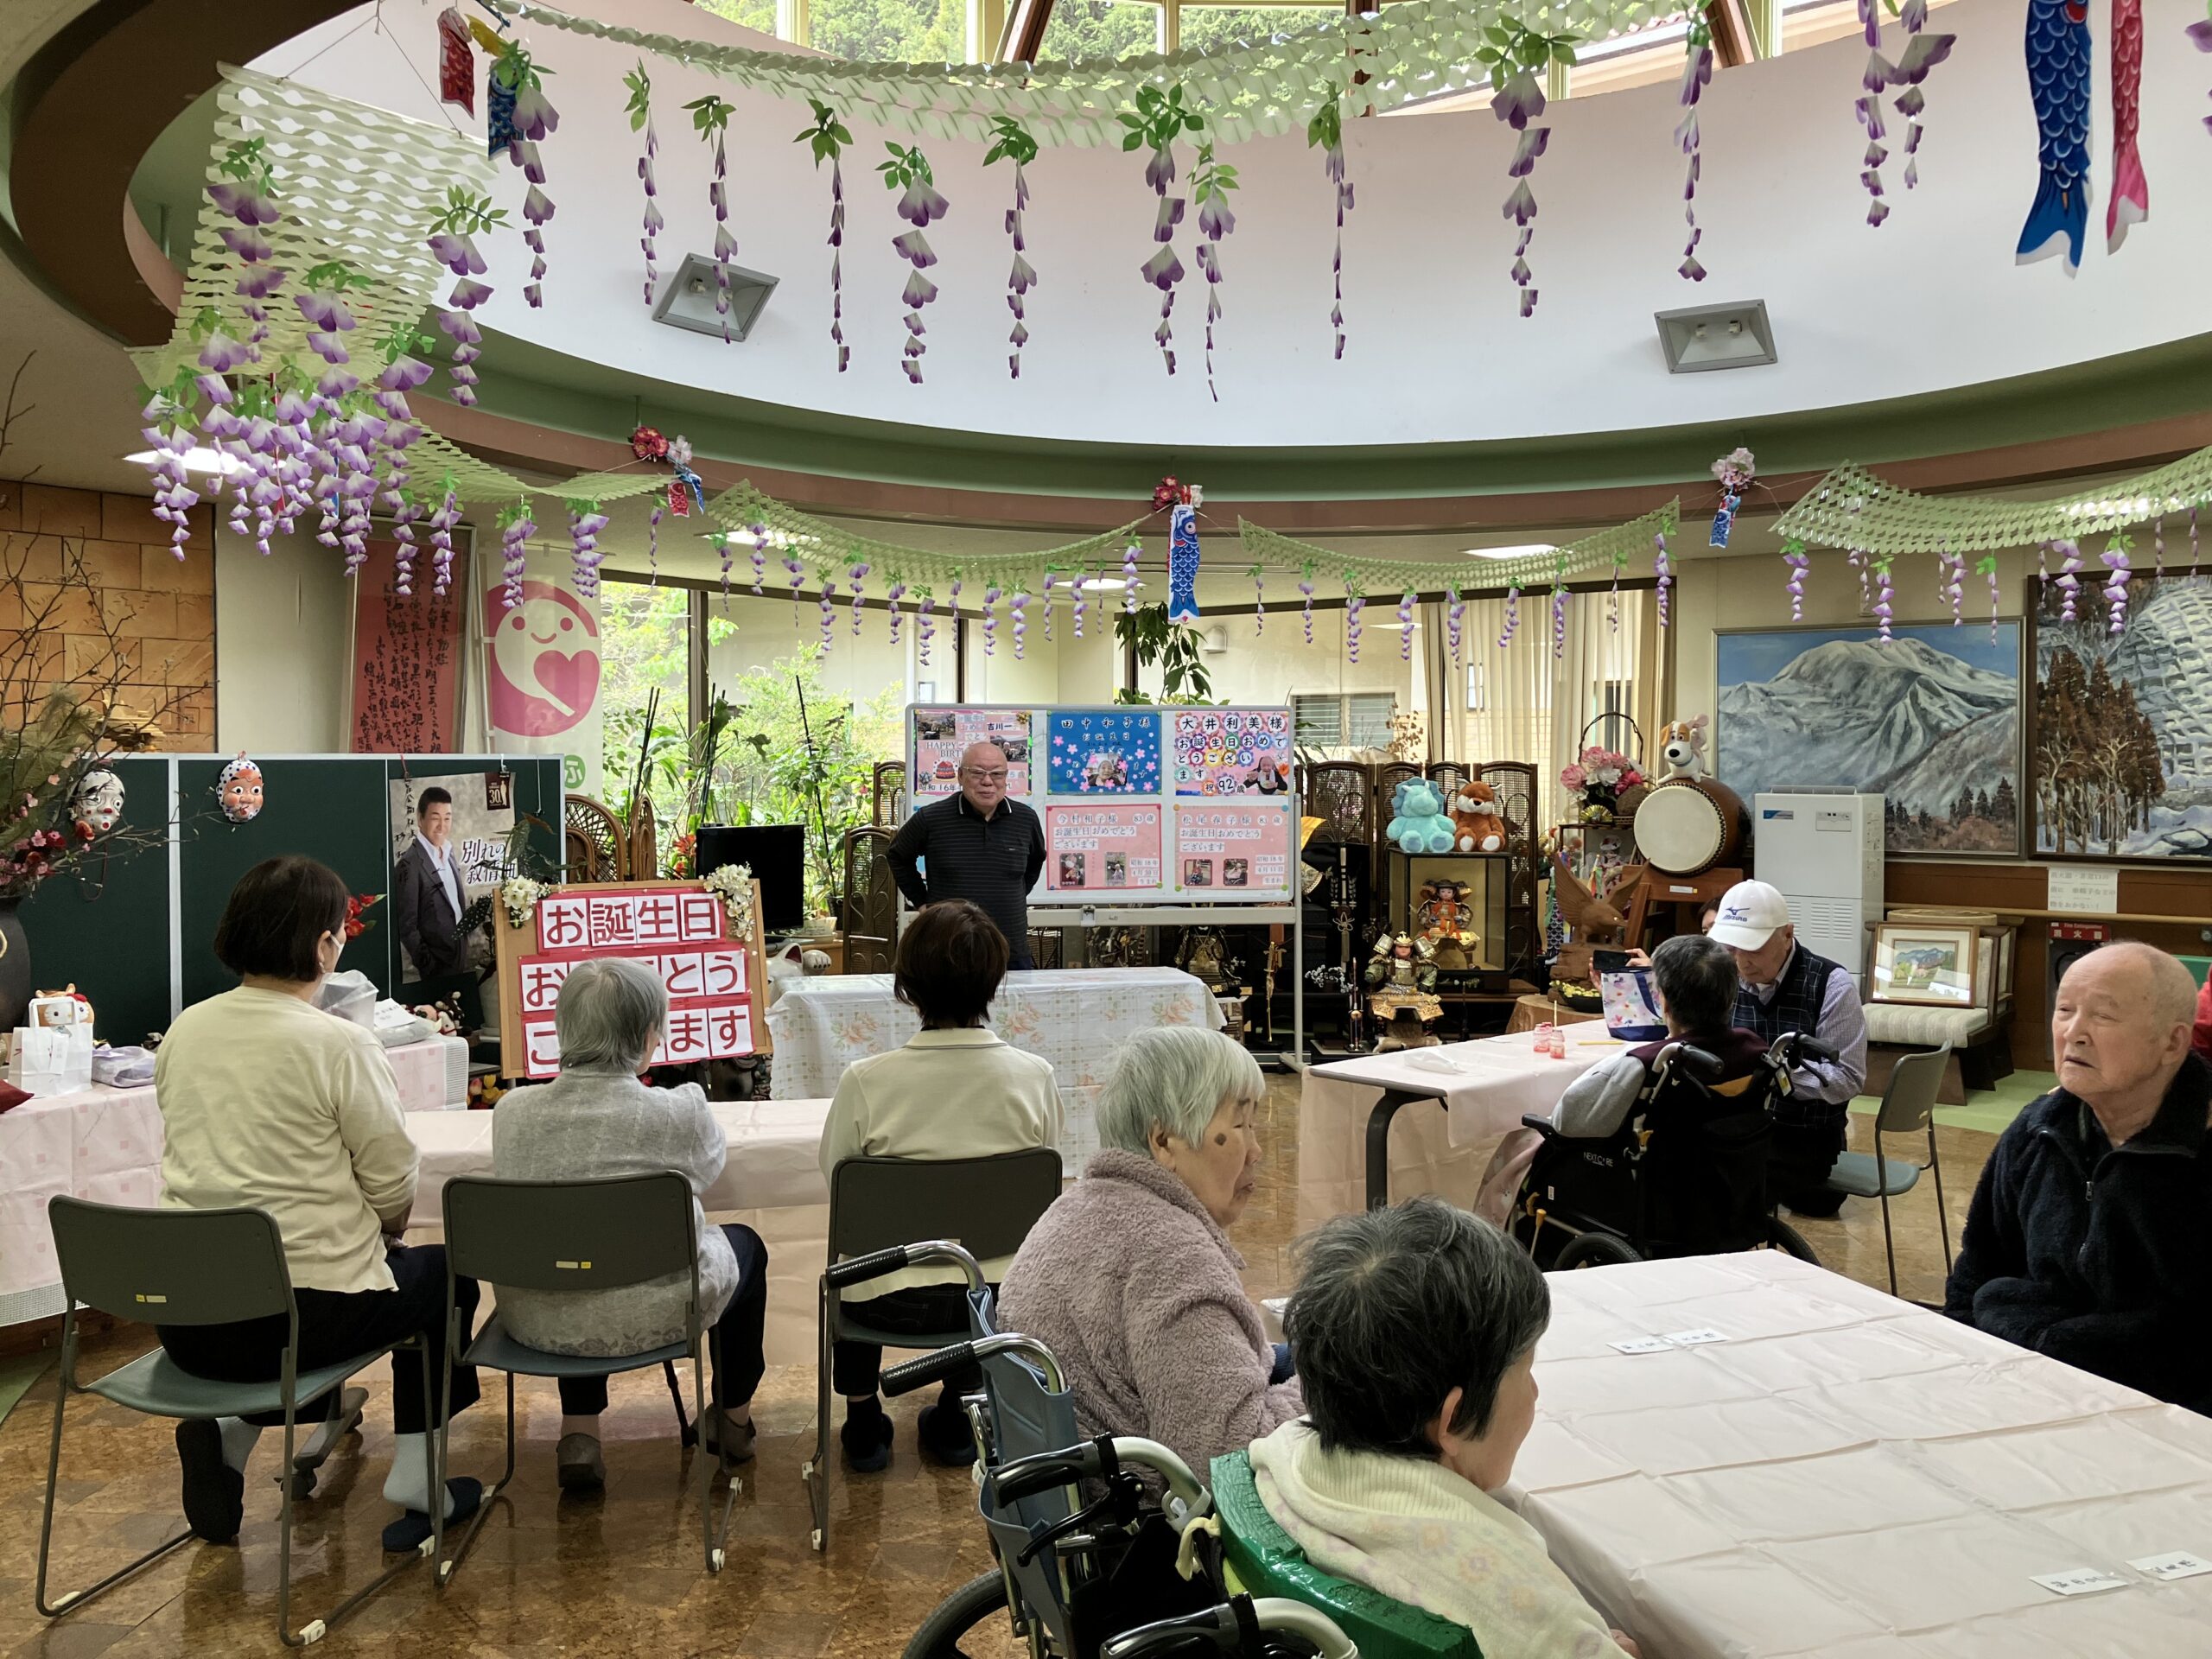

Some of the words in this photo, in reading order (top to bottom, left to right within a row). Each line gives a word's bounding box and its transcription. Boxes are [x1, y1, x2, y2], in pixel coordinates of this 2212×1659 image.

[1061, 715, 1151, 730] 田中和子様
[1181, 716, 1283, 731] 大井利美様
[1178, 735, 1286, 750] お誕生日おめで
[1179, 768, 1204, 780] ます
[1058, 814, 1118, 824] 今村和子様
[1182, 815, 1250, 825] 松尾春子様
[1054, 839, 1098, 849] ございます
[1181, 842, 1224, 852] ございます
[545, 898, 716, 945] お誕生日
[525, 954, 739, 1007] おとう
